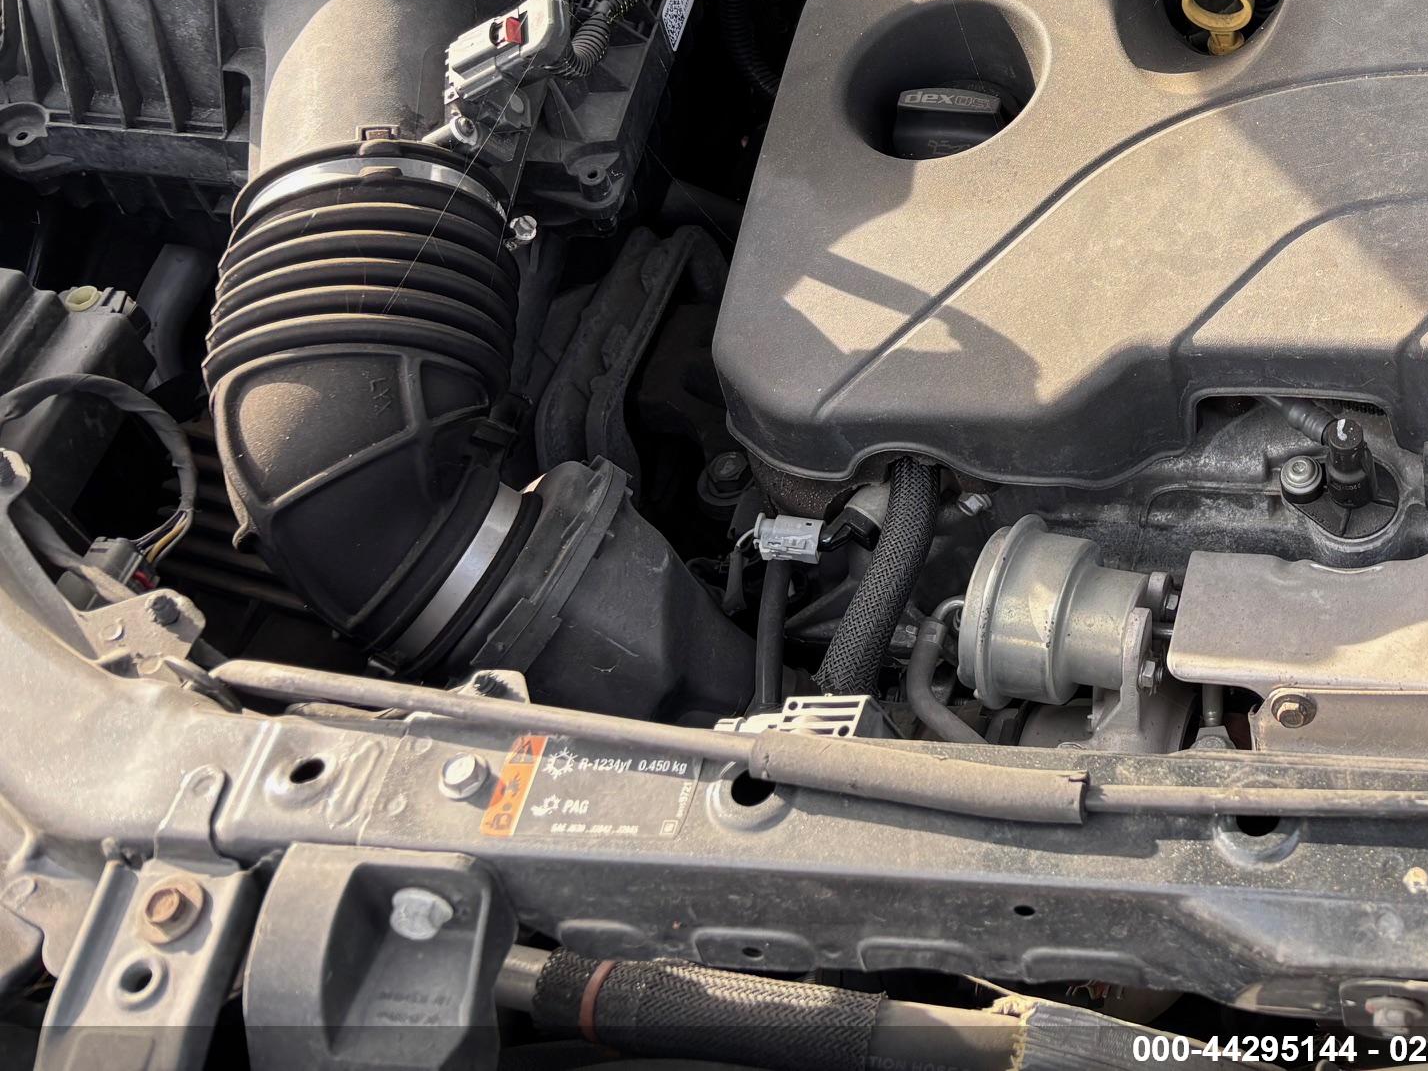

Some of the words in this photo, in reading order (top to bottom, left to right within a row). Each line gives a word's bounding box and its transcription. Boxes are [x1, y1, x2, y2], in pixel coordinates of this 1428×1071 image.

[578, 757, 633, 774] R-1234yf
[638, 759, 671, 772] 0.450
[671, 761, 688, 775] kg
[562, 799, 590, 815] PAG
